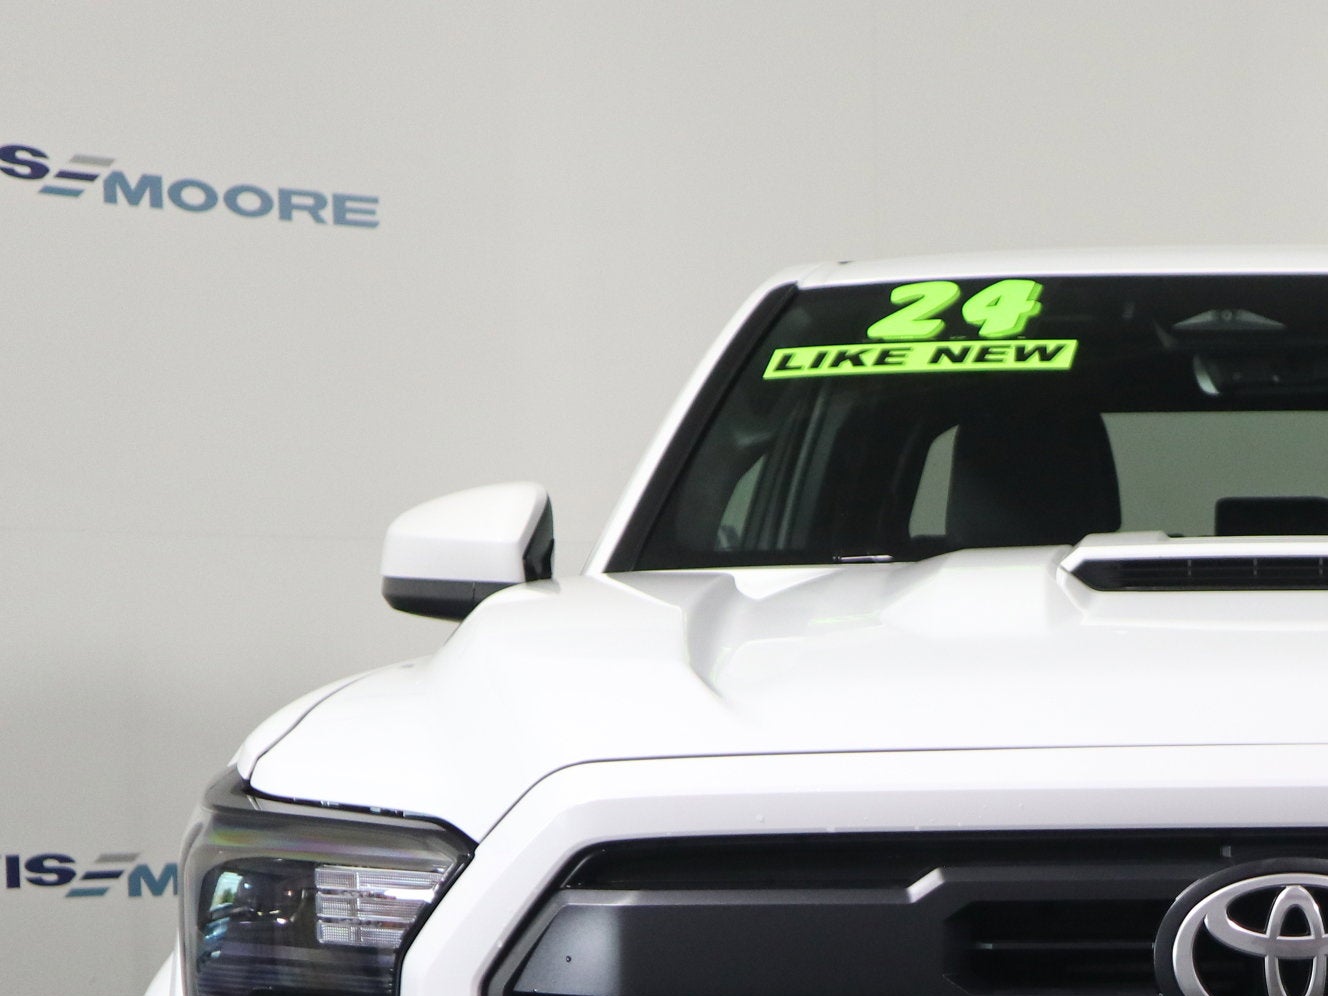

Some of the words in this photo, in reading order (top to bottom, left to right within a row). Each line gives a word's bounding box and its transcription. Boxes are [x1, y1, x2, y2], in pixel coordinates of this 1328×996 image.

[102, 170, 380, 229] MOORE
[866, 279, 1044, 340] 24
[772, 346, 912, 373] LIKE
[926, 343, 1069, 364] NEW
